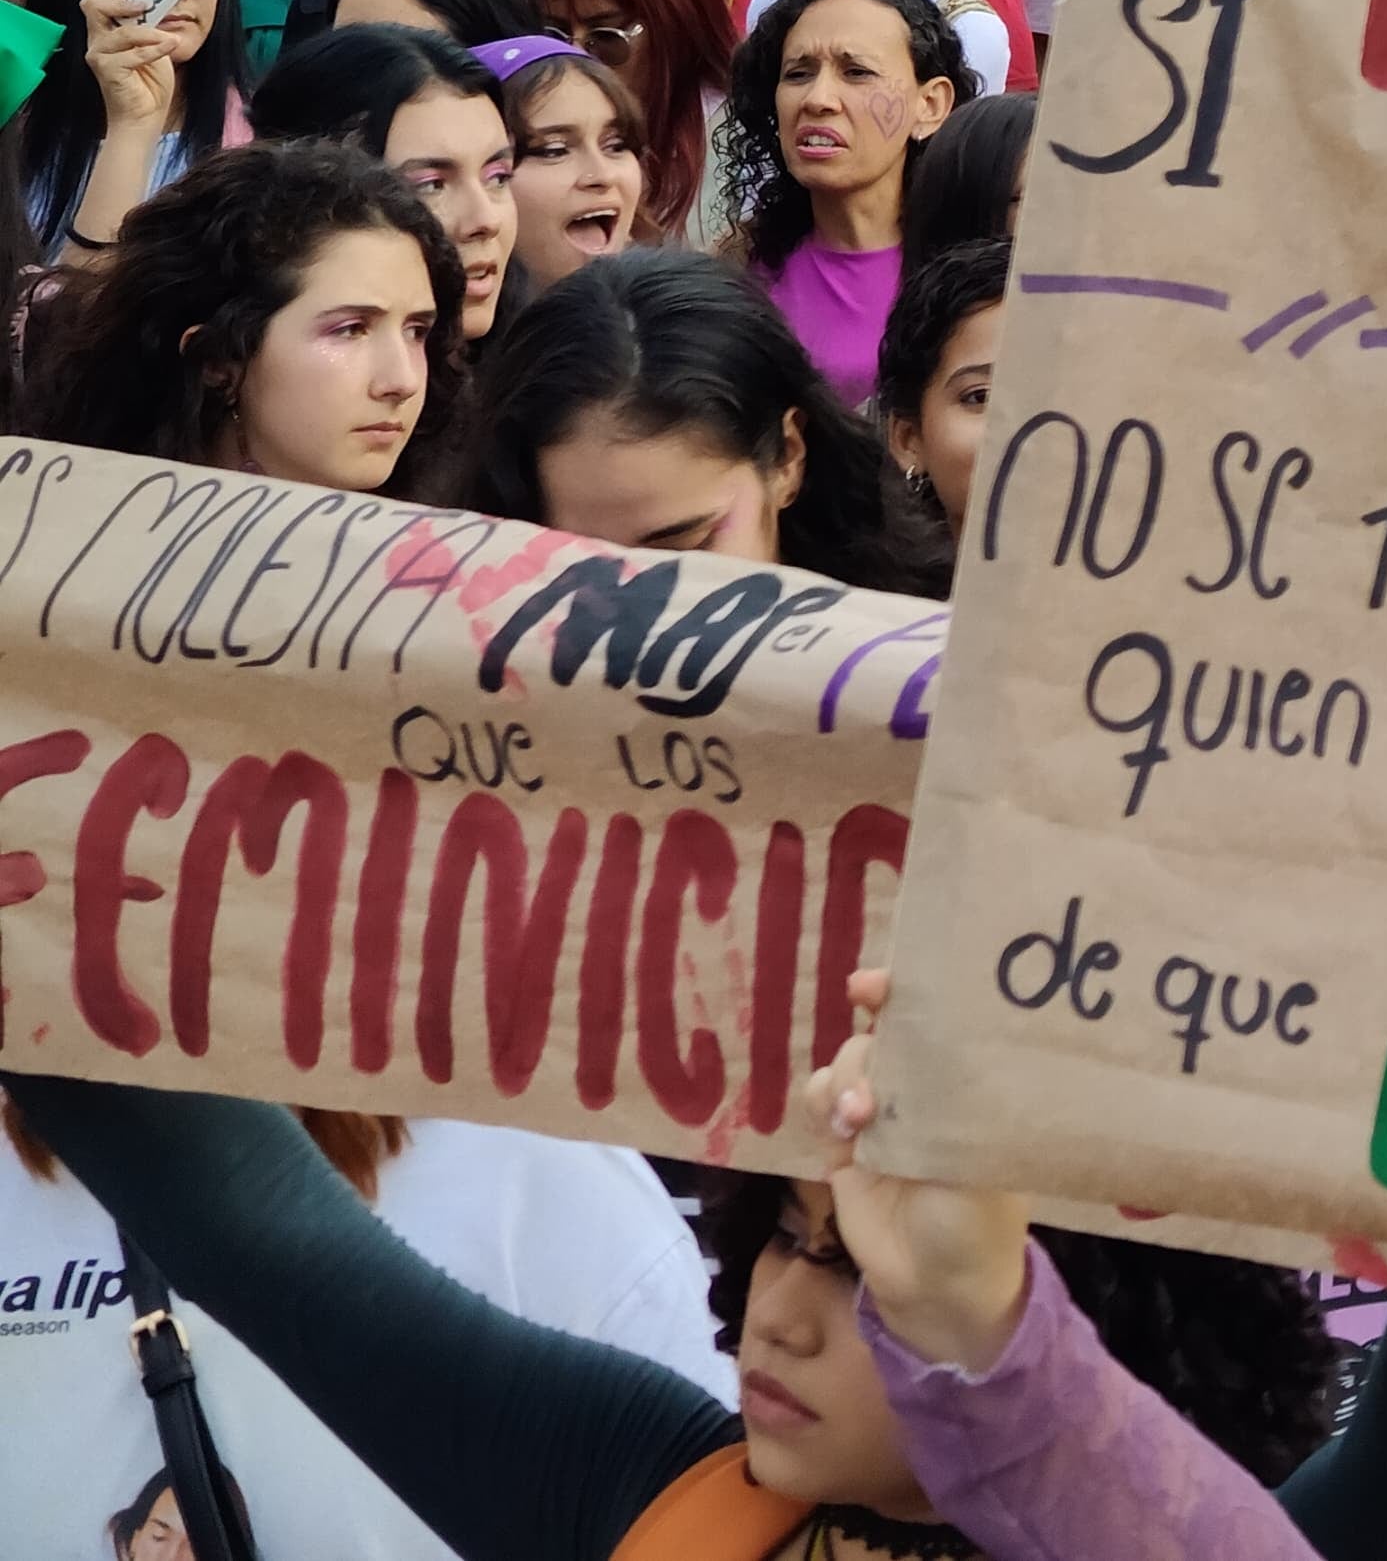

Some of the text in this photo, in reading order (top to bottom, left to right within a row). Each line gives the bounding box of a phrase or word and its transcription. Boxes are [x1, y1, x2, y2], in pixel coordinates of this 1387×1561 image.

[39, 470, 498, 675] MOLESTA
[614, 730, 742, 803] LOS
[997, 894, 1114, 1027] de
[1150, 948, 1316, 1076] que
[0, 1258, 130, 1320] a lip
